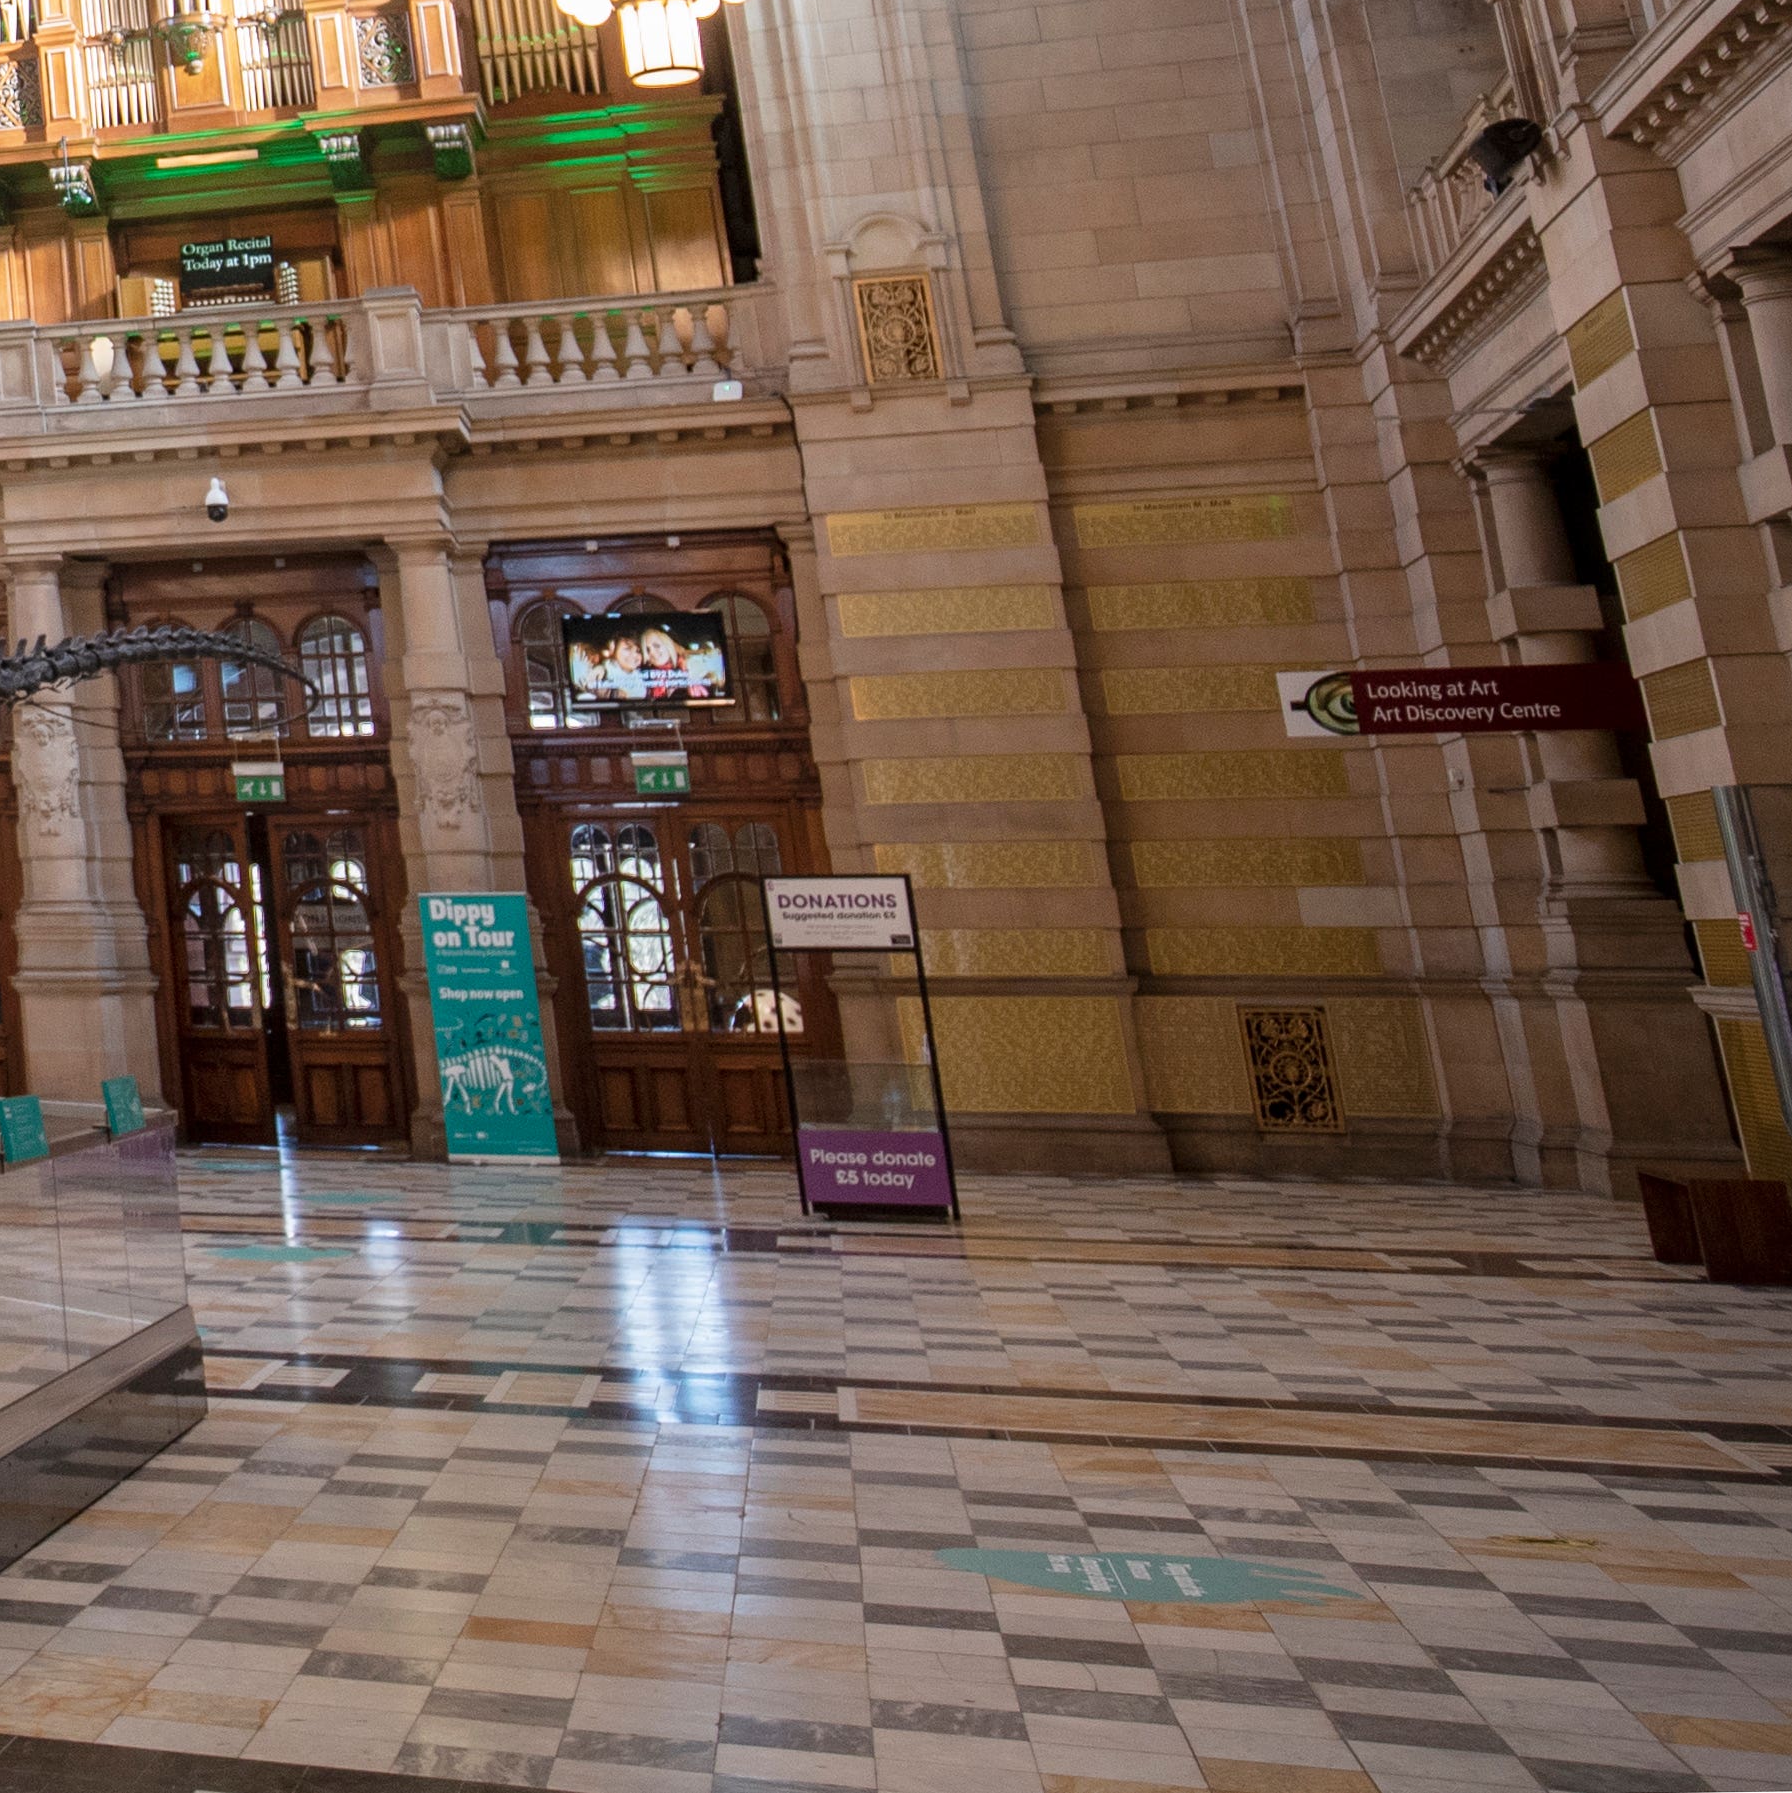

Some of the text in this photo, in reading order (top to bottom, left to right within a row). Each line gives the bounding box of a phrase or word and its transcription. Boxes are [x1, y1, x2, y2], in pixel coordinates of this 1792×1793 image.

[182, 236, 271, 257] Organ Recital
[183, 253, 272, 272] Today at 1pm
[1367, 680, 1499, 701] Looking at Art
[1373, 702, 1561, 724] Art Discovery Centre
[778, 894, 897, 909] DONATIONS
[429, 898, 495, 926] Dippy
[782, 912, 833, 922] Suggested
[837, 912, 881, 920] donation
[433, 926, 515, 949] on Tour
[439, 987, 524, 1002] Shop now open
[810, 1149, 936, 1166] Please donate
[835, 1170, 915, 1190] £5 today
